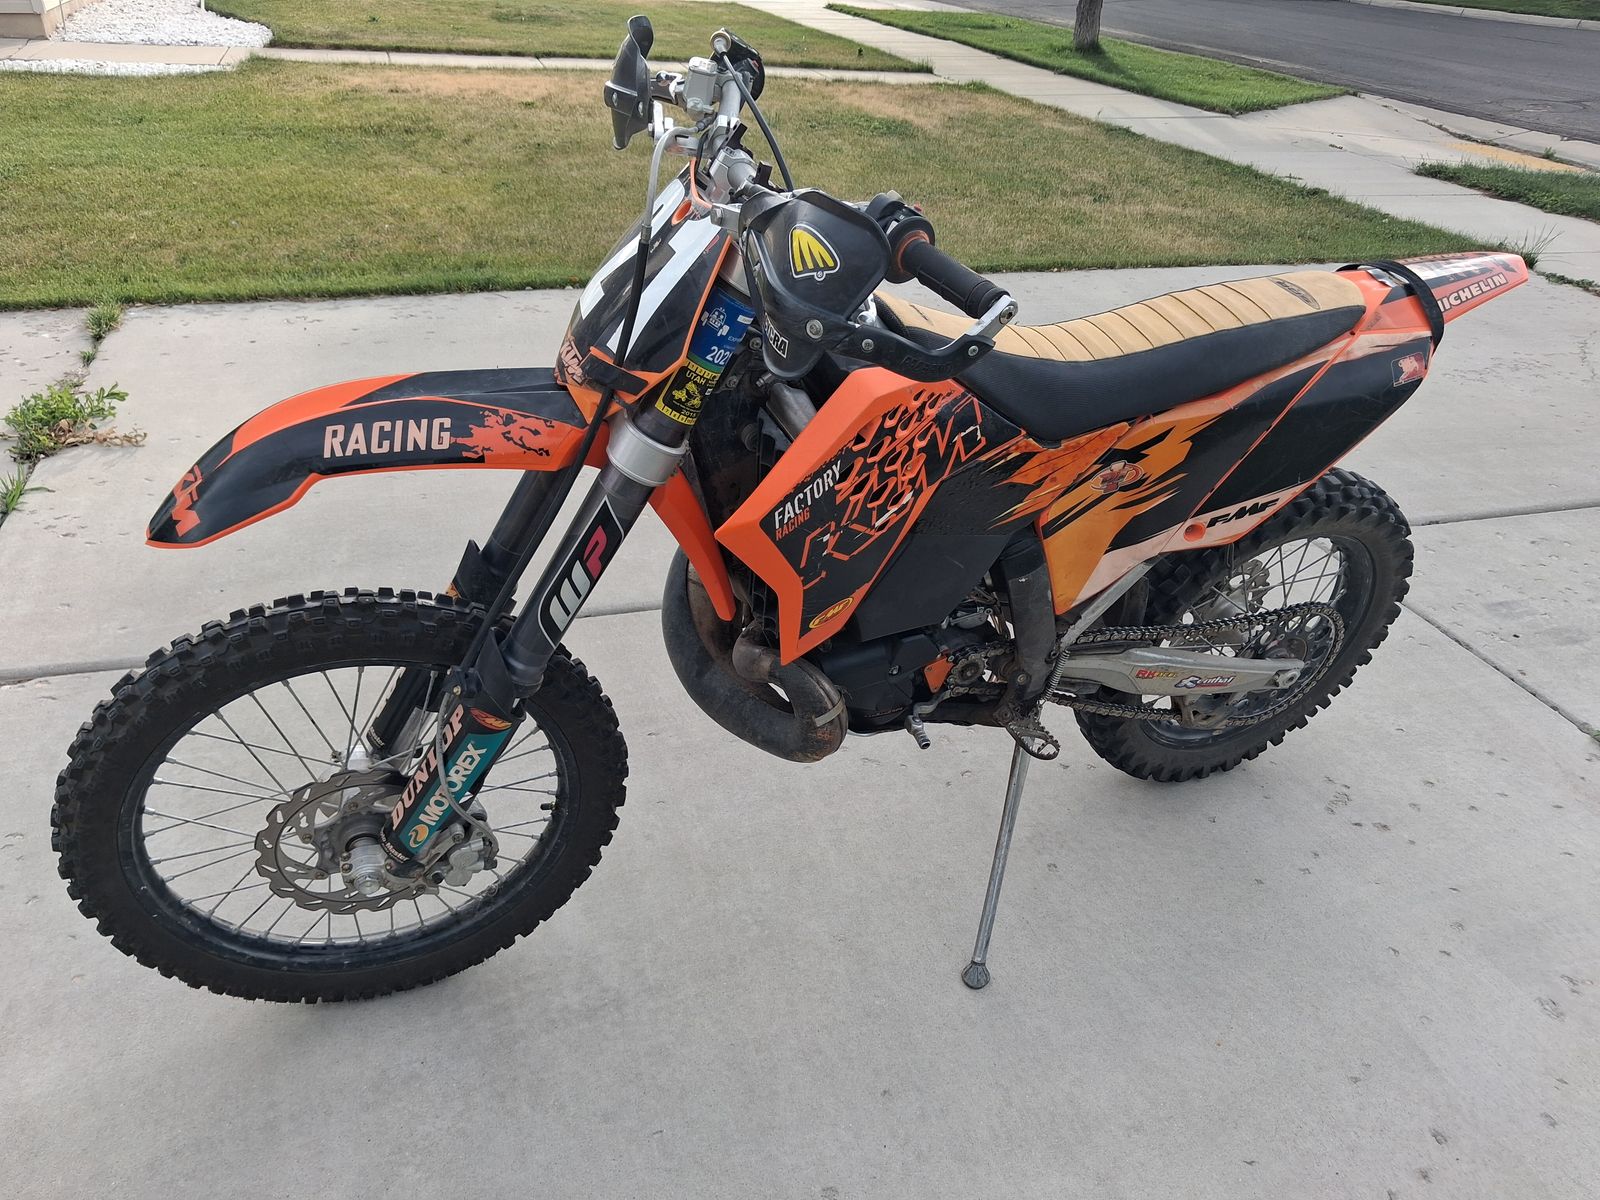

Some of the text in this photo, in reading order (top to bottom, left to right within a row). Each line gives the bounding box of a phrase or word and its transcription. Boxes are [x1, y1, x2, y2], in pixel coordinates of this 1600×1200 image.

[705, 346, 734, 365] 202
[685, 370, 707, 386] UTAH
[322, 416, 452, 459] RACING
[774, 459, 842, 530] FACTORY
[1206, 498, 1280, 529] FMF
[775, 507, 811, 542] RACING
[391, 703, 464, 831] DUNLOP
[417, 742, 488, 826] MOTOREX
